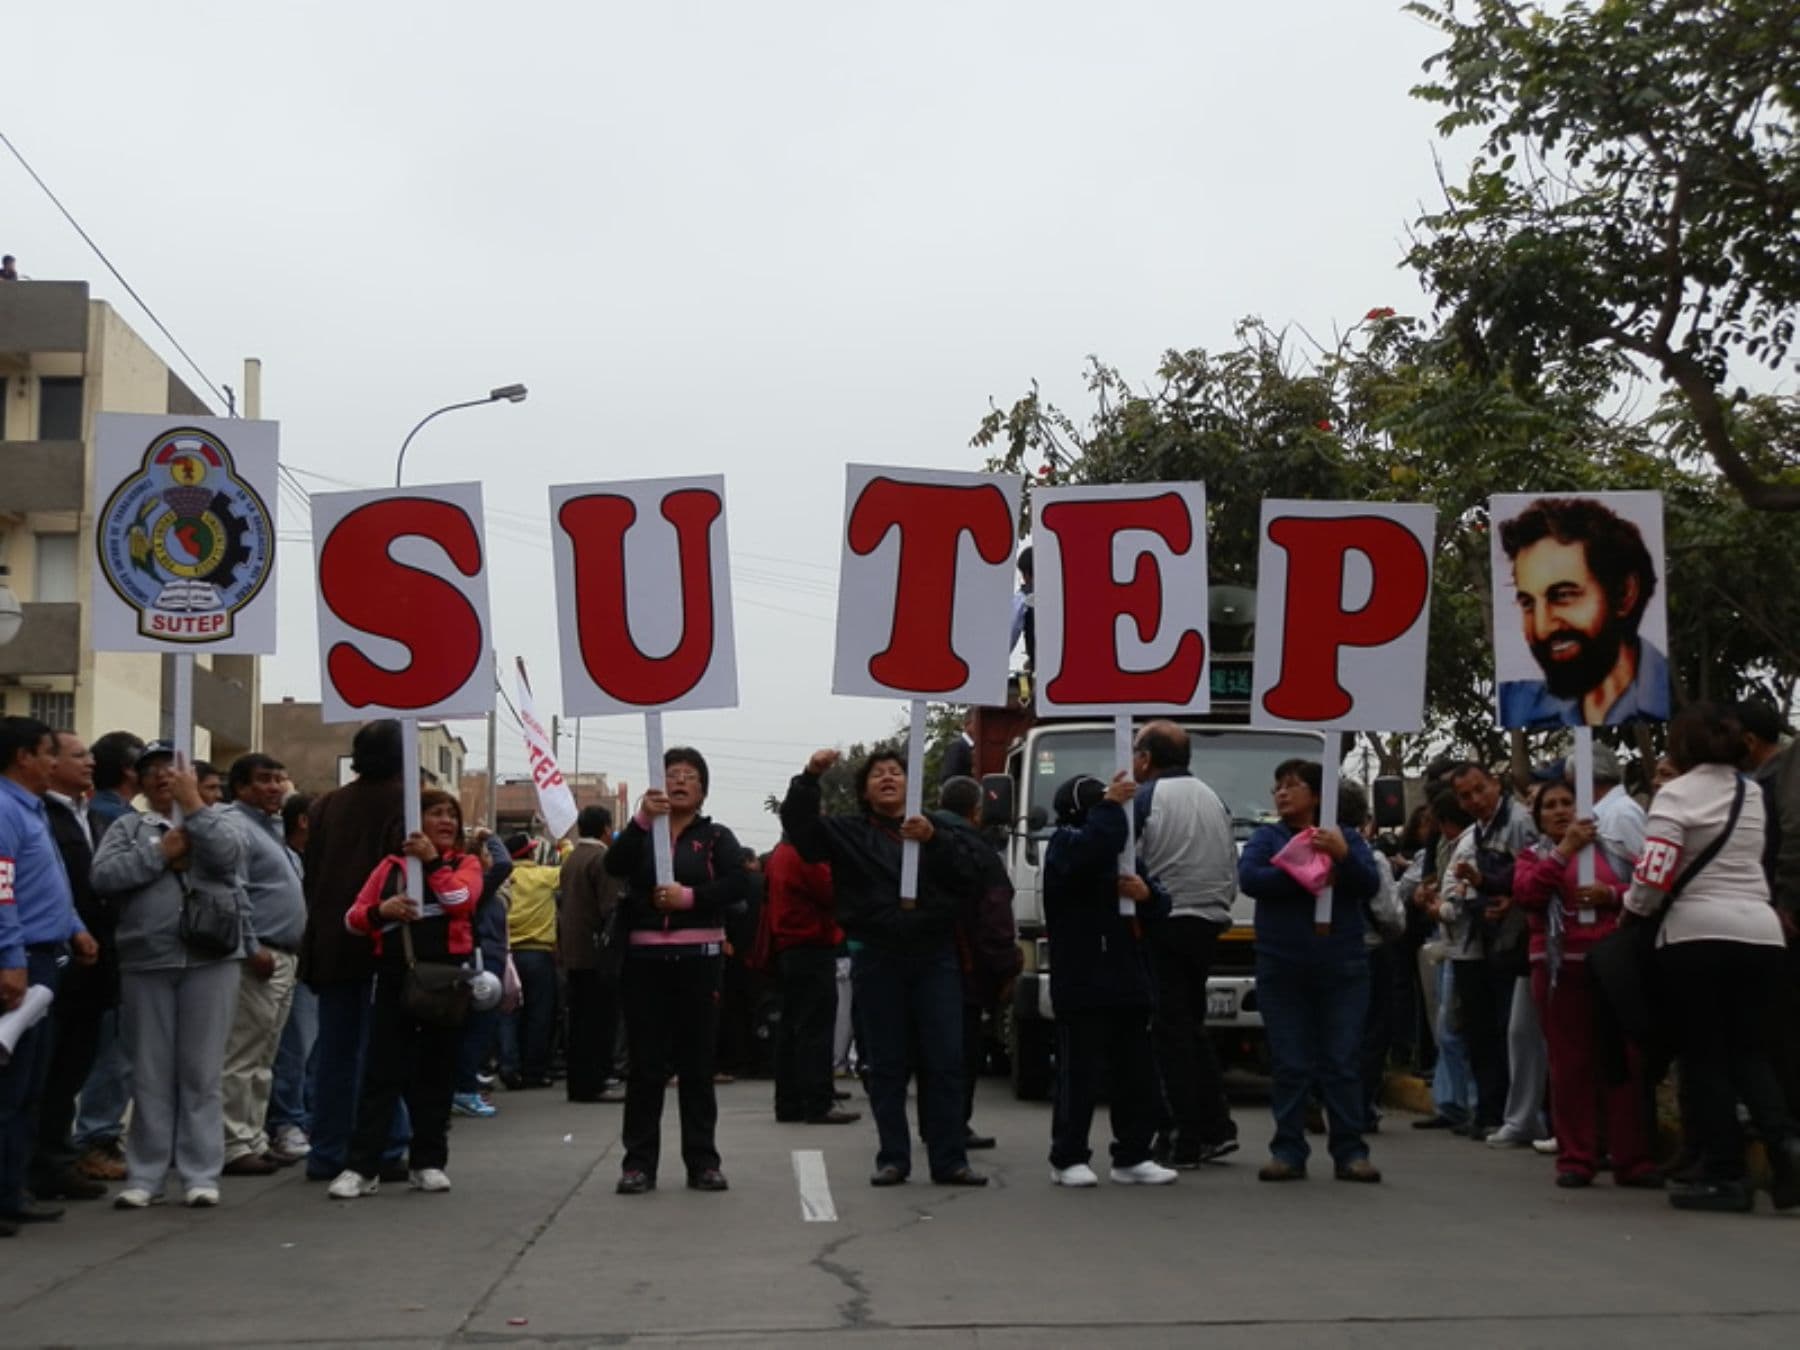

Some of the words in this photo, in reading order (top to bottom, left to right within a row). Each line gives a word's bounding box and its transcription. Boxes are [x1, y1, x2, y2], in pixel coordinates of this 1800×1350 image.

[152, 613, 225, 632] SUTEP
[318, 497, 482, 711] S
[558, 489, 723, 707] U
[847, 477, 1014, 694] T
[1040, 492, 1204, 705] E
[1263, 516, 1428, 722] P
